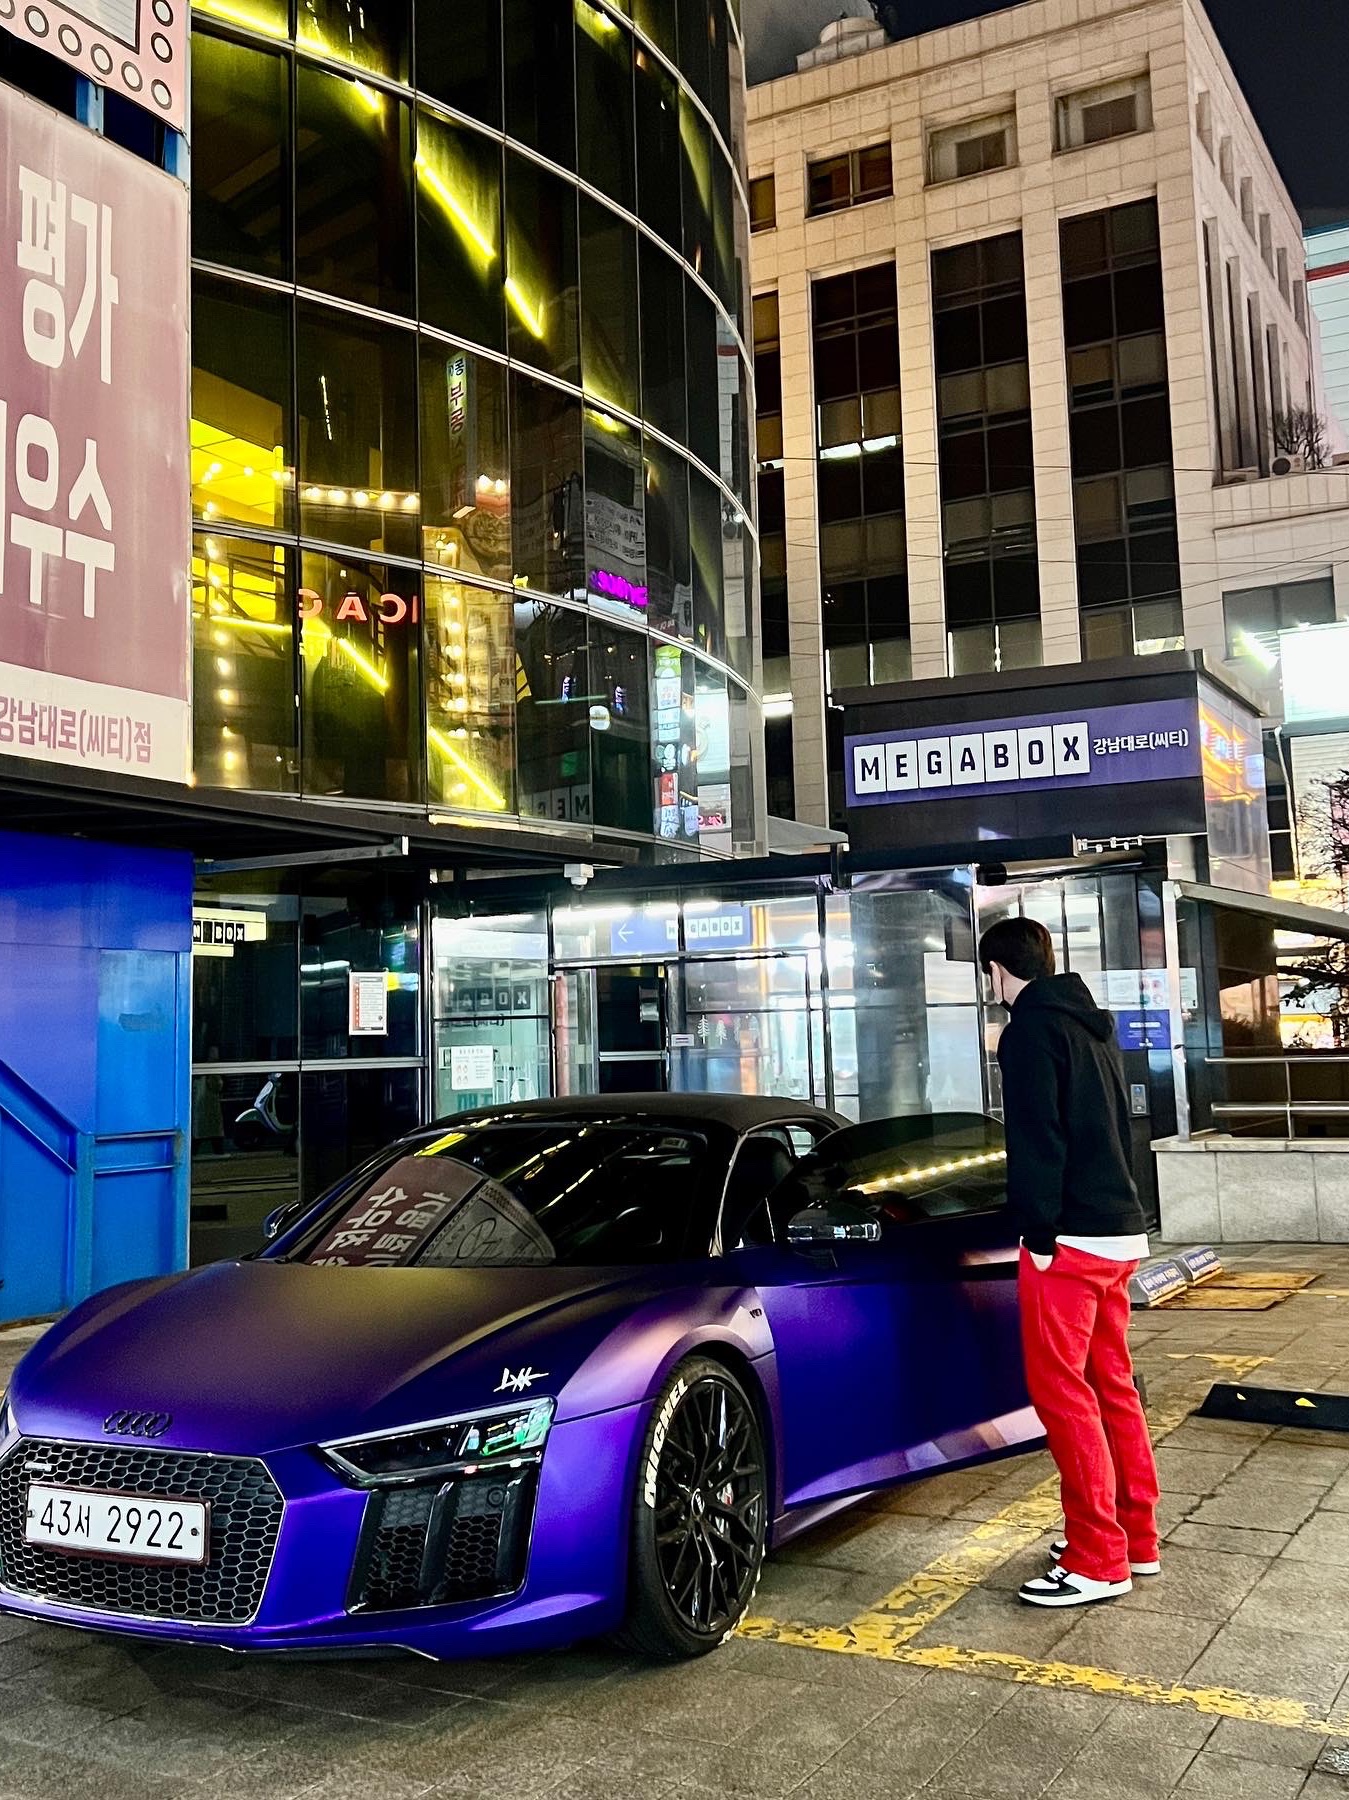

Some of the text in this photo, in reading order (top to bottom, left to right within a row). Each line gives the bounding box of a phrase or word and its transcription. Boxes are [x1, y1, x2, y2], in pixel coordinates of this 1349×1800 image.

[17, 164, 119, 385] 평가
[0, 398, 115, 620] 우수
[0, 695, 152, 764] 강남대로(씨티)점
[860, 736, 1080, 782] MEGABOX
[1093, 728, 1188, 755] 강남대로(씨티)
[667, 920, 741, 935] MGABOX
[40, 1498, 184, 1550] 43서 2922
